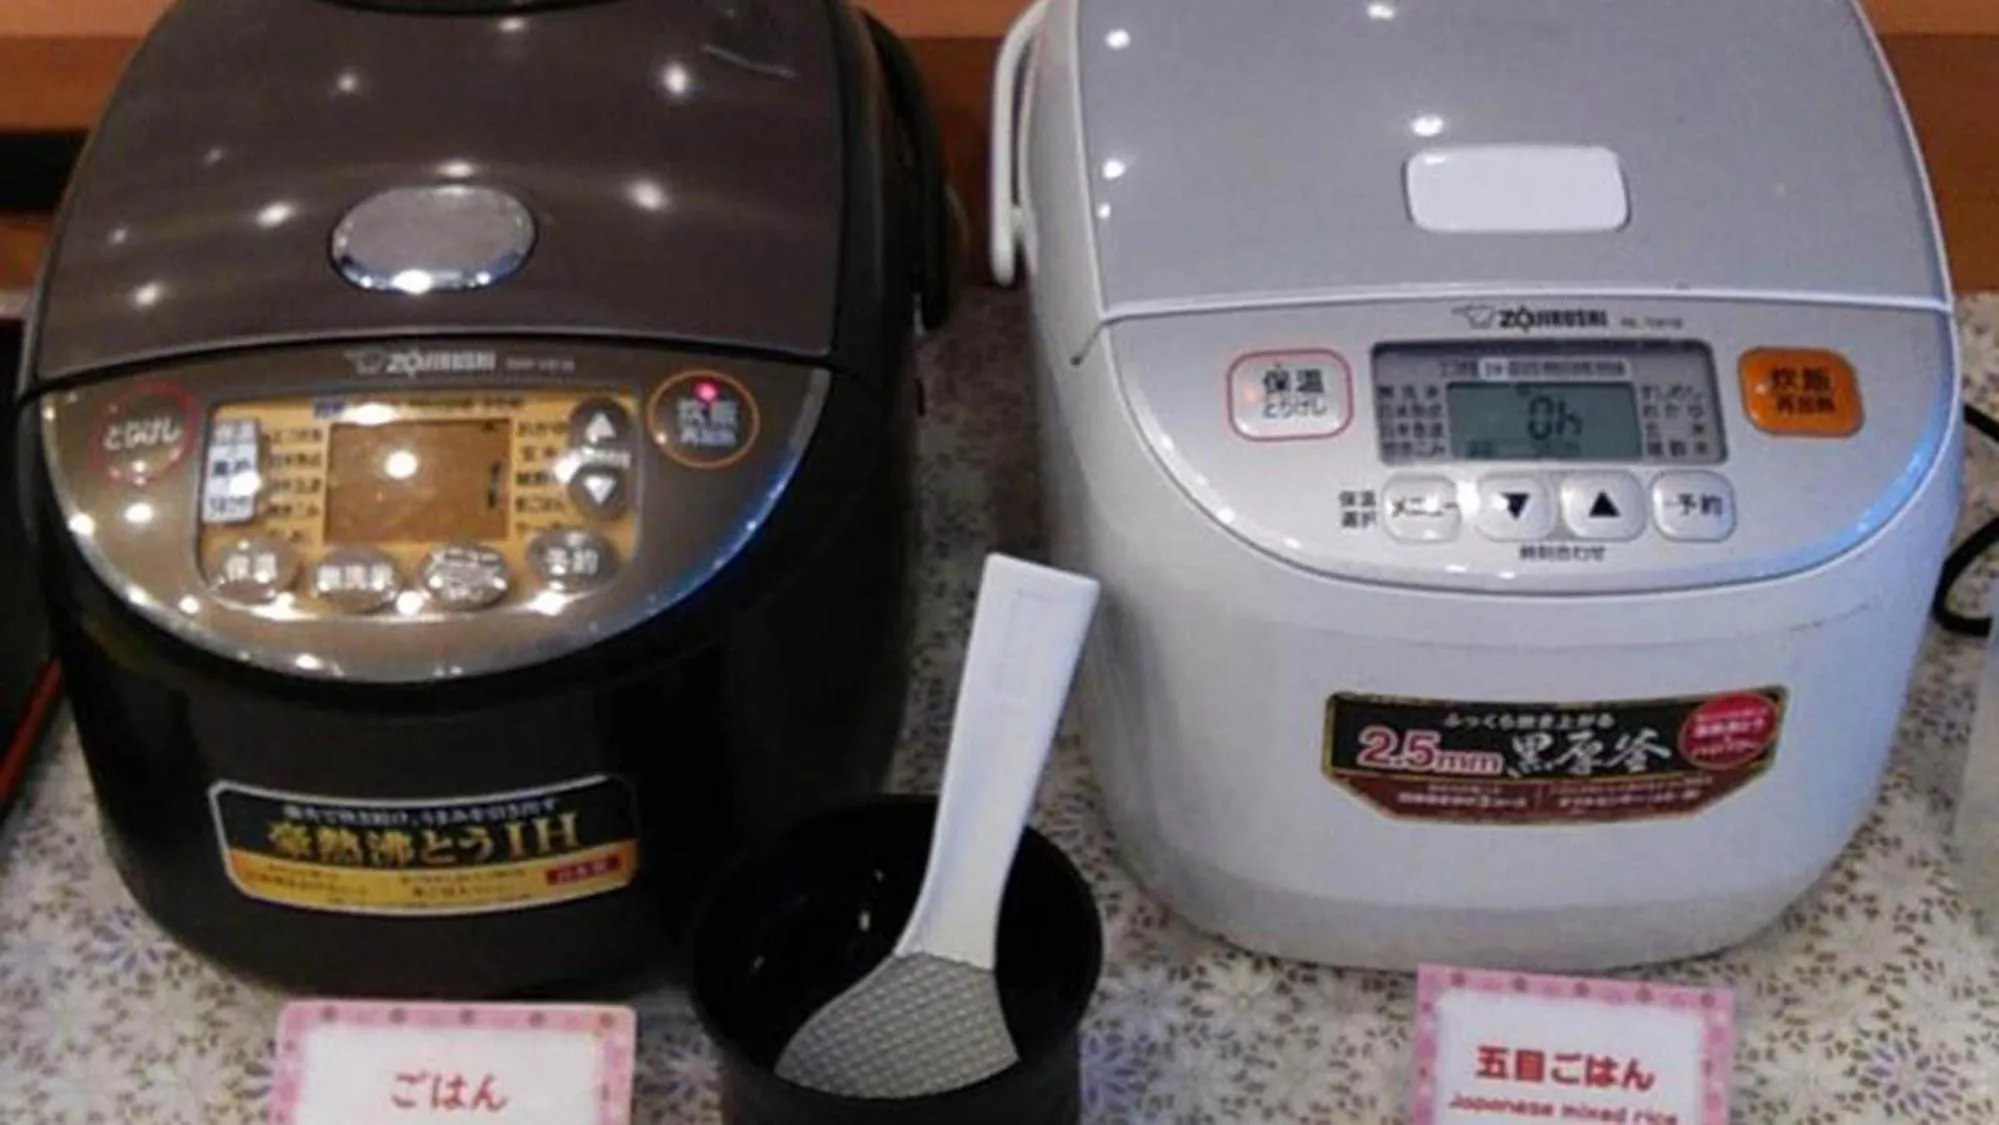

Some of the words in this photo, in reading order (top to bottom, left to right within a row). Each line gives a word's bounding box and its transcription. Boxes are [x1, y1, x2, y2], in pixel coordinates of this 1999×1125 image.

[1500, 306, 1608, 333] ZOJIRUSHI
[1262, 363, 1325, 394] 保温
[1262, 399, 1328, 419] とりけし
[104, 416, 183, 450] とりけし
[1357, 725, 1502, 773] 2.5mm
[391, 1070, 509, 1112] ごはん
[1449, 1091, 1554, 1117] Japanese
[1562, 1104, 1627, 1122] mixed
